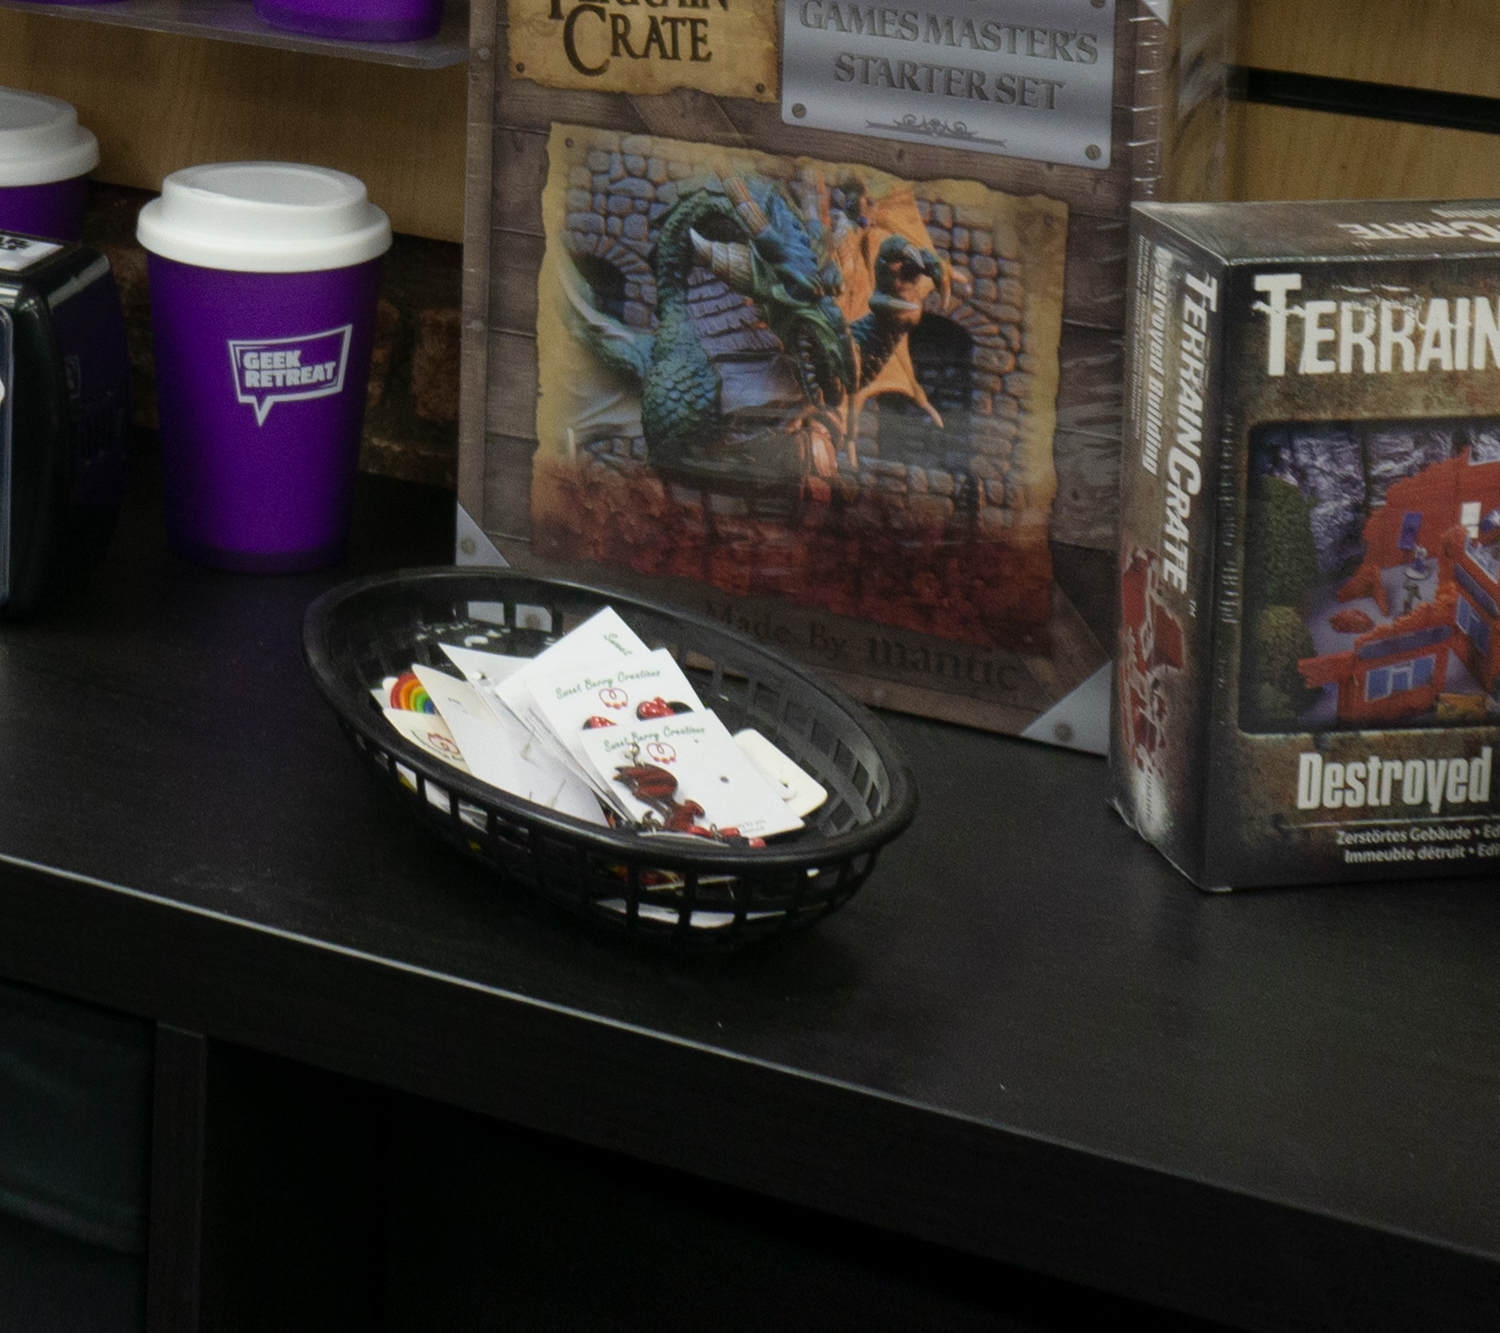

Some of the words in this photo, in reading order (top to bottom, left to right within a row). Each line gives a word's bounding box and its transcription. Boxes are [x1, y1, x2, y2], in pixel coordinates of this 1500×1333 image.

[562, 5, 713, 77] CRATE
[834, 50, 990, 107] STARTER
[995, 70, 1066, 113] SET
[242, 349, 304, 372] GEEK
[243, 362, 338, 390] RETREAT
[1297, 745, 1493, 813] Destroyed
